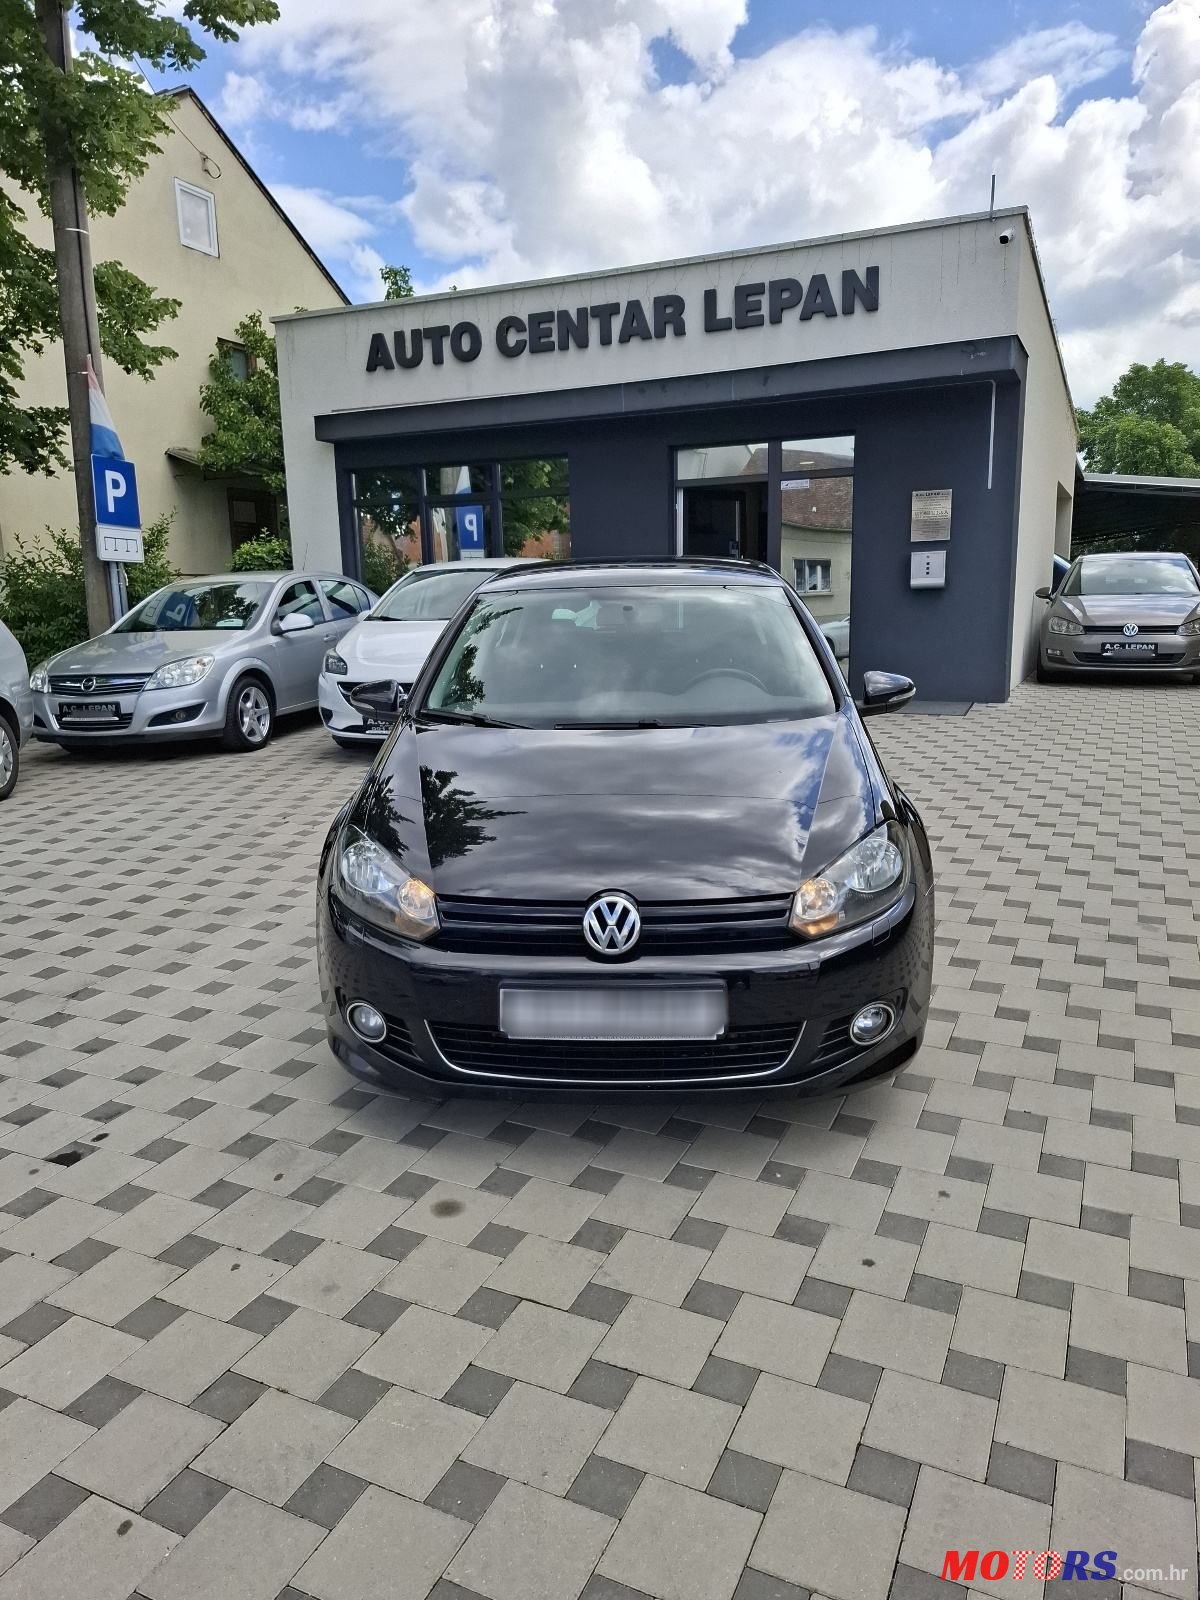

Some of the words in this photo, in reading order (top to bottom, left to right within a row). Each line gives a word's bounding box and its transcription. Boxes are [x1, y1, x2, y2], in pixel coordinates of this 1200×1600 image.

[366, 321, 482, 373] AUTO
[496, 294, 686, 358] CENTAR
[704, 266, 880, 333] LEPAN
[105, 469, 127, 513] P
[83, 704, 116, 712] LEPAN
